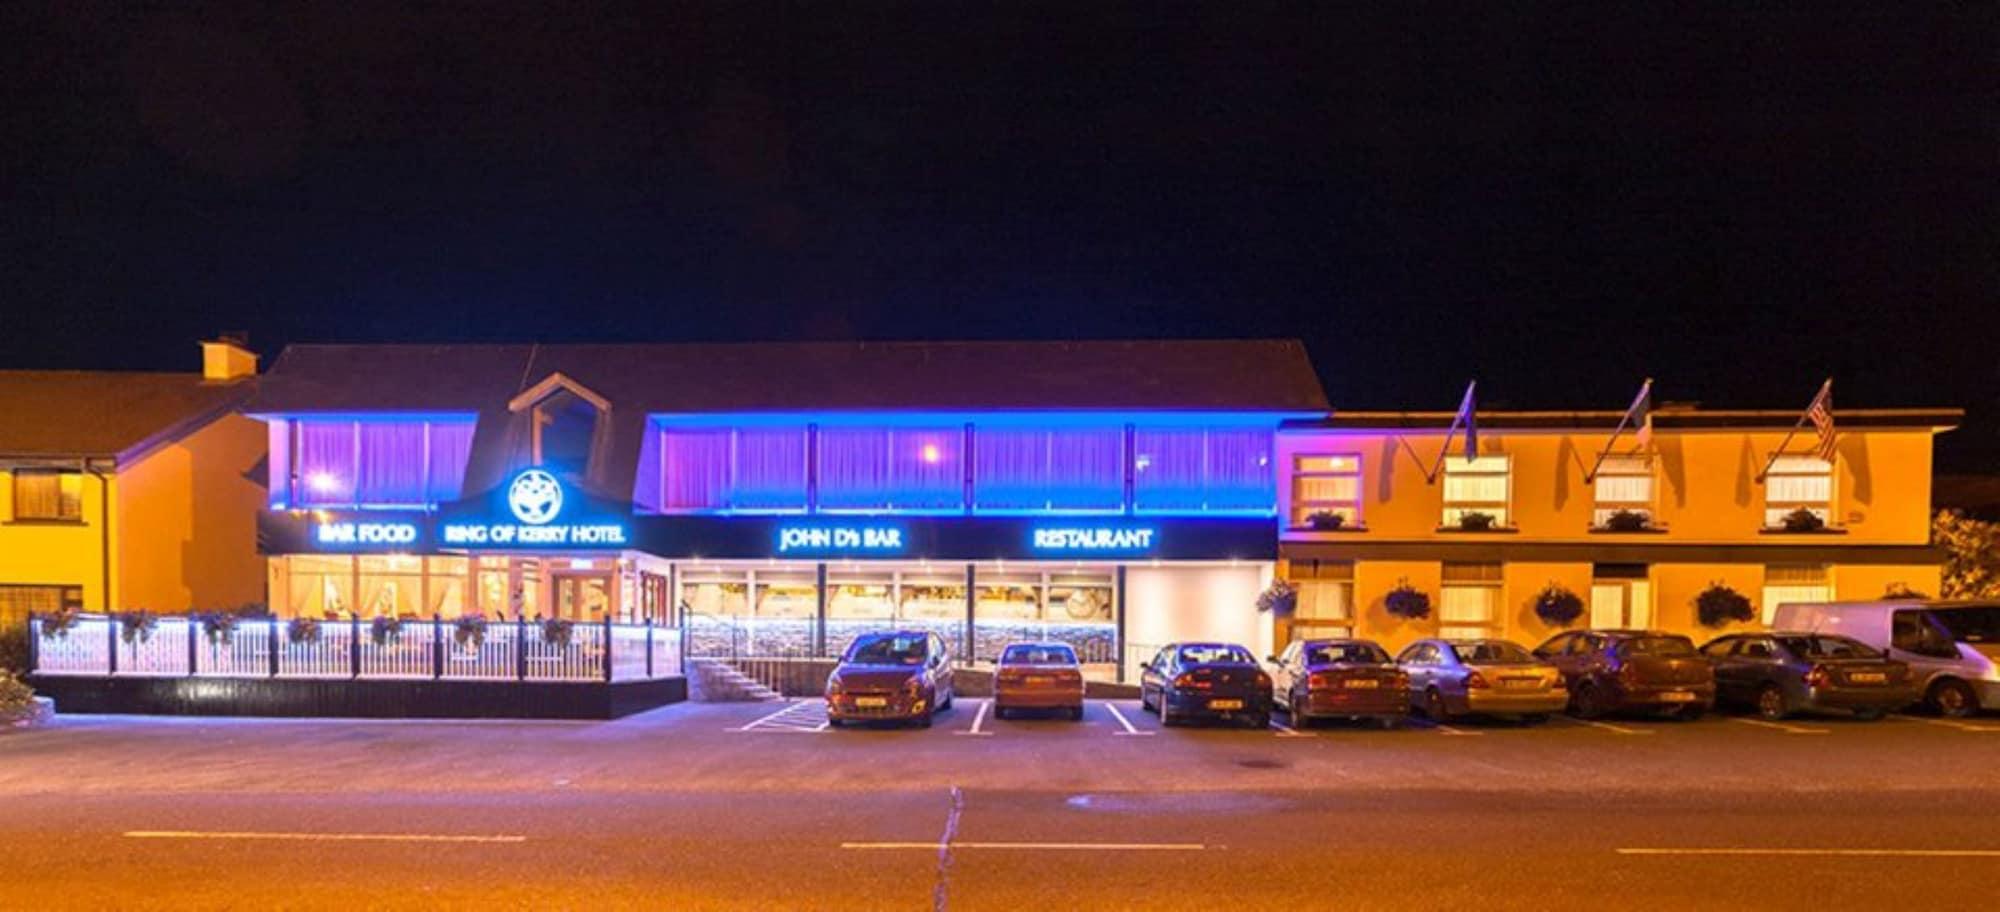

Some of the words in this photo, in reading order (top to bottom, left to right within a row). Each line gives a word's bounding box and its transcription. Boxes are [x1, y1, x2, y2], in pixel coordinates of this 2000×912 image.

[318, 523, 356, 542] BAR
[358, 523, 416, 542] FOOD
[444, 525, 487, 542] RING
[490, 525, 516, 542] OF
[517, 525, 570, 542] KERRY
[571, 525, 626, 542] HOTEL
[779, 528, 831, 551] JOHN
[863, 528, 902, 547] BAR
[1034, 528, 1154, 548] RESTAURANT
